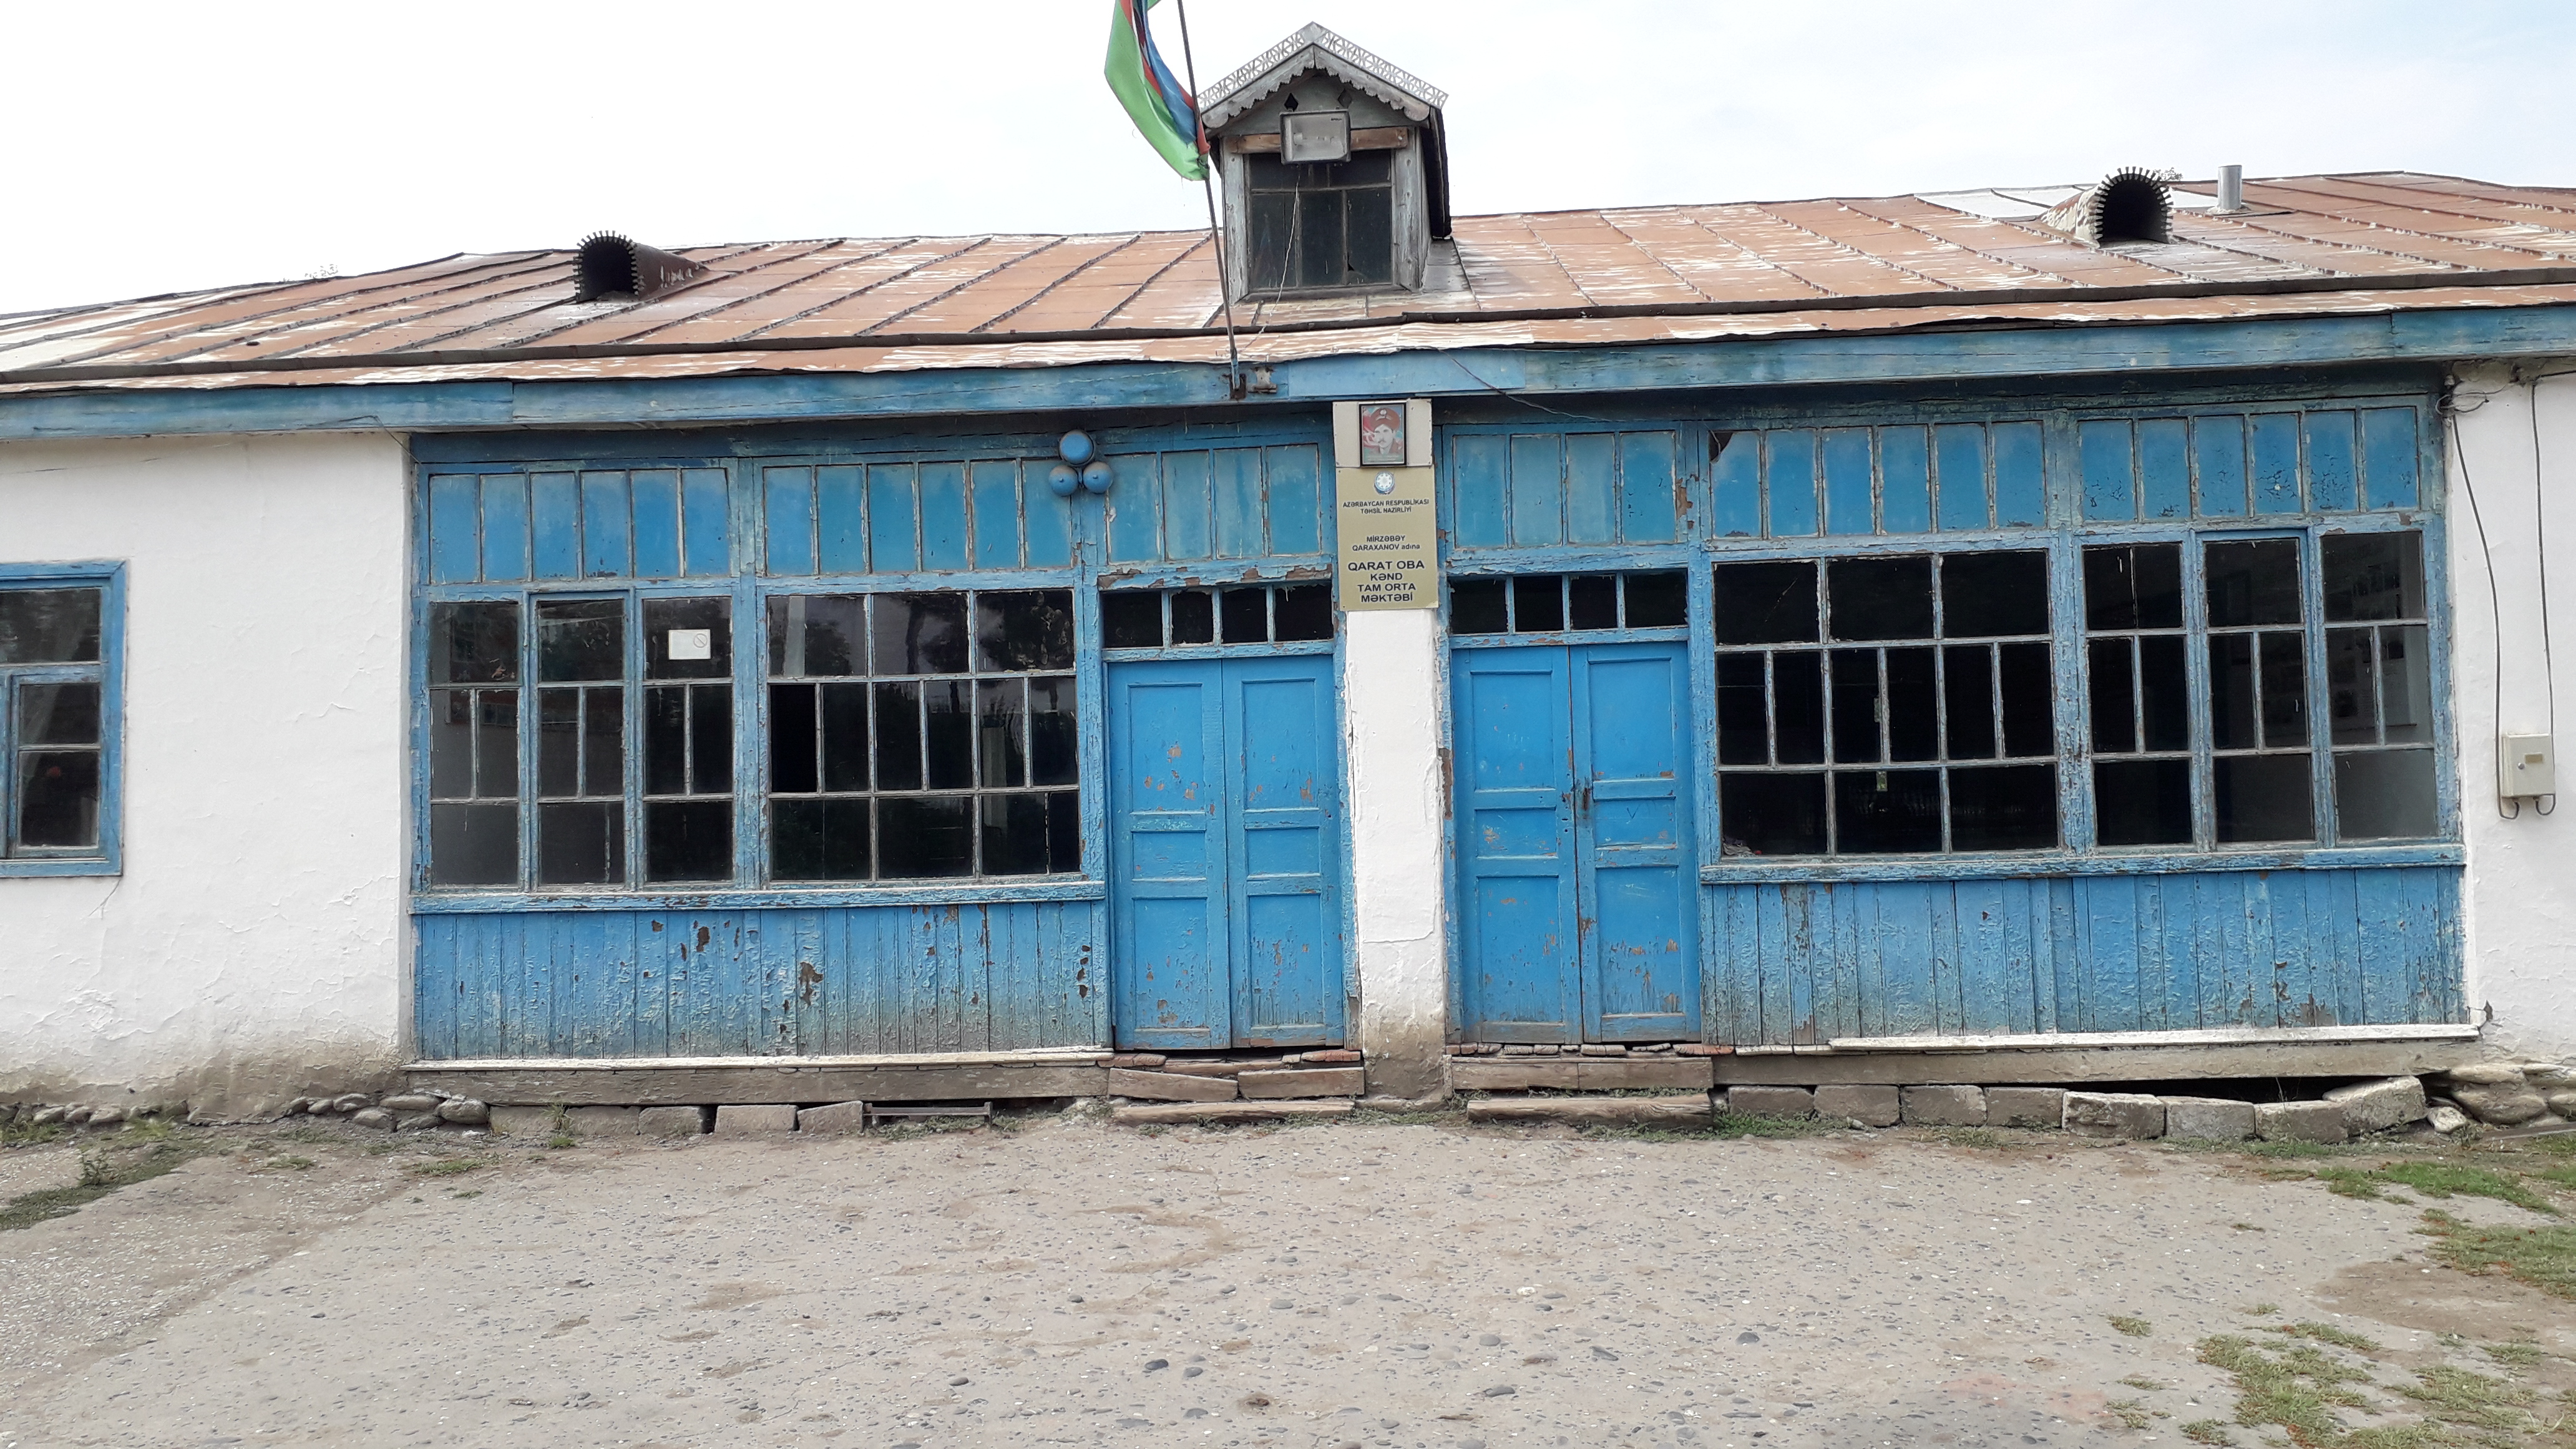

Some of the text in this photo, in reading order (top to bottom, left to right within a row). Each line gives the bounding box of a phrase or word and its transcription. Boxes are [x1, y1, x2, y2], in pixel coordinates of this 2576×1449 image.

[1348, 560, 1425, 571] QARAT OBA
[1370, 573, 1403, 581] KƏND
[1385, 583, 1416, 591] ORTA
[1361, 592, 1413, 602] MƏKTƏBİ
